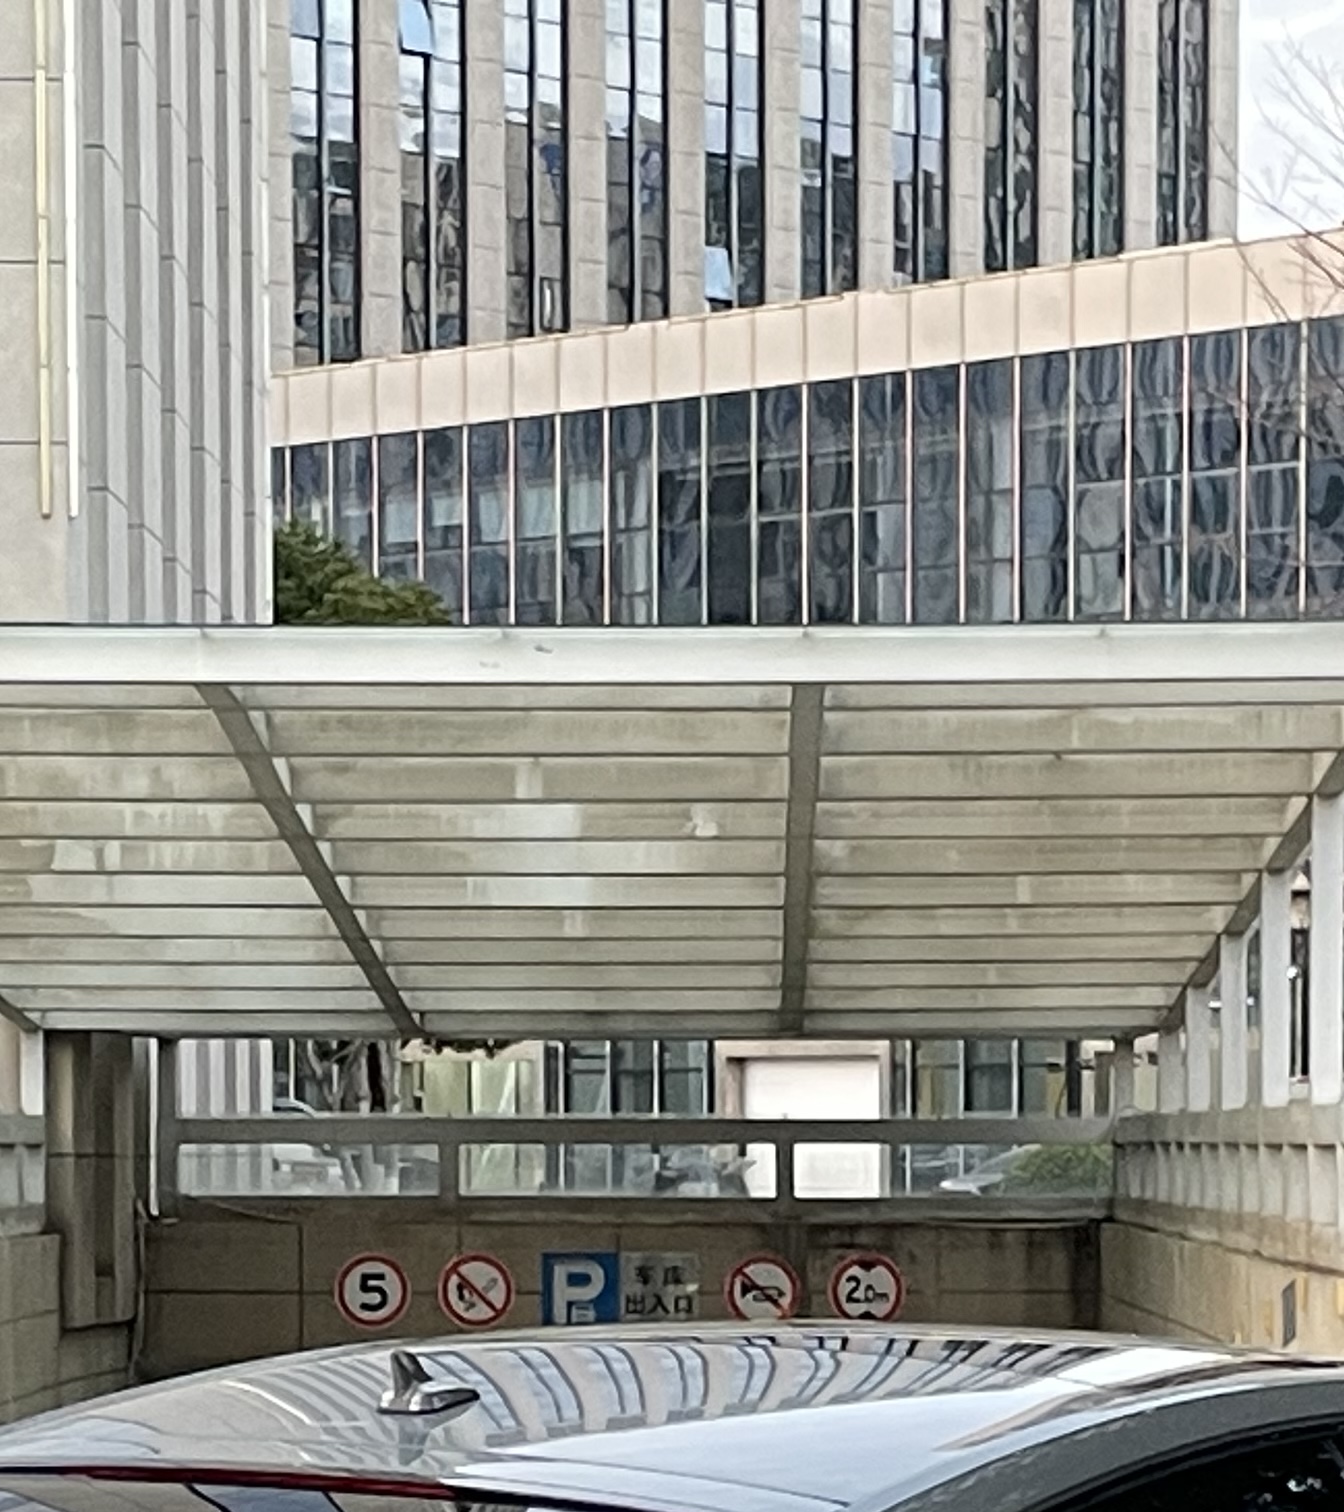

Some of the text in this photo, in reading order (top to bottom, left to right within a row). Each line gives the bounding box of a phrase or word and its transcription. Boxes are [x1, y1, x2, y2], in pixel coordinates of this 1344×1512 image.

[359, 1272, 388, 1312] 5
[553, 1259, 605, 1325] P
[625, 1293, 694, 1316] 出入口
